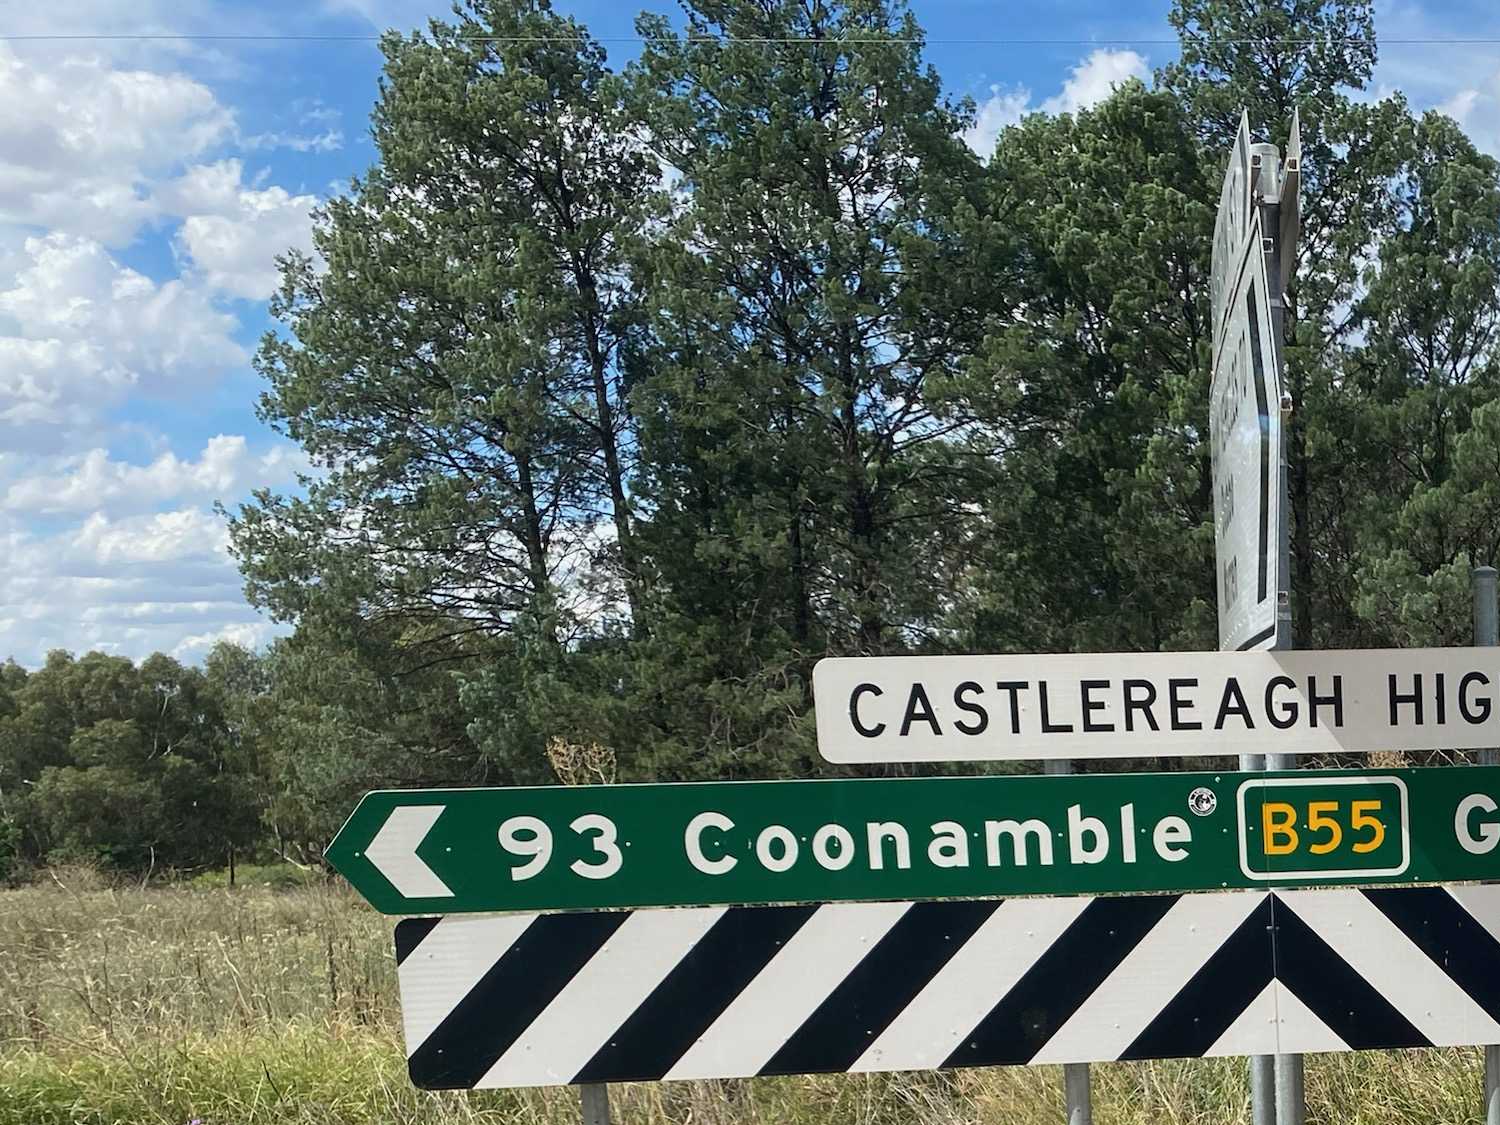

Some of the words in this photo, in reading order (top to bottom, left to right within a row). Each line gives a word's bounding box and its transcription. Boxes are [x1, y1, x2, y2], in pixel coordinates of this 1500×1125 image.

[849, 675, 1344, 738] CASTLEREAGH
[497, 813, 623, 882] 93
[684, 802, 1193, 875] Coonamble
[1262, 800, 1386, 855] B55
